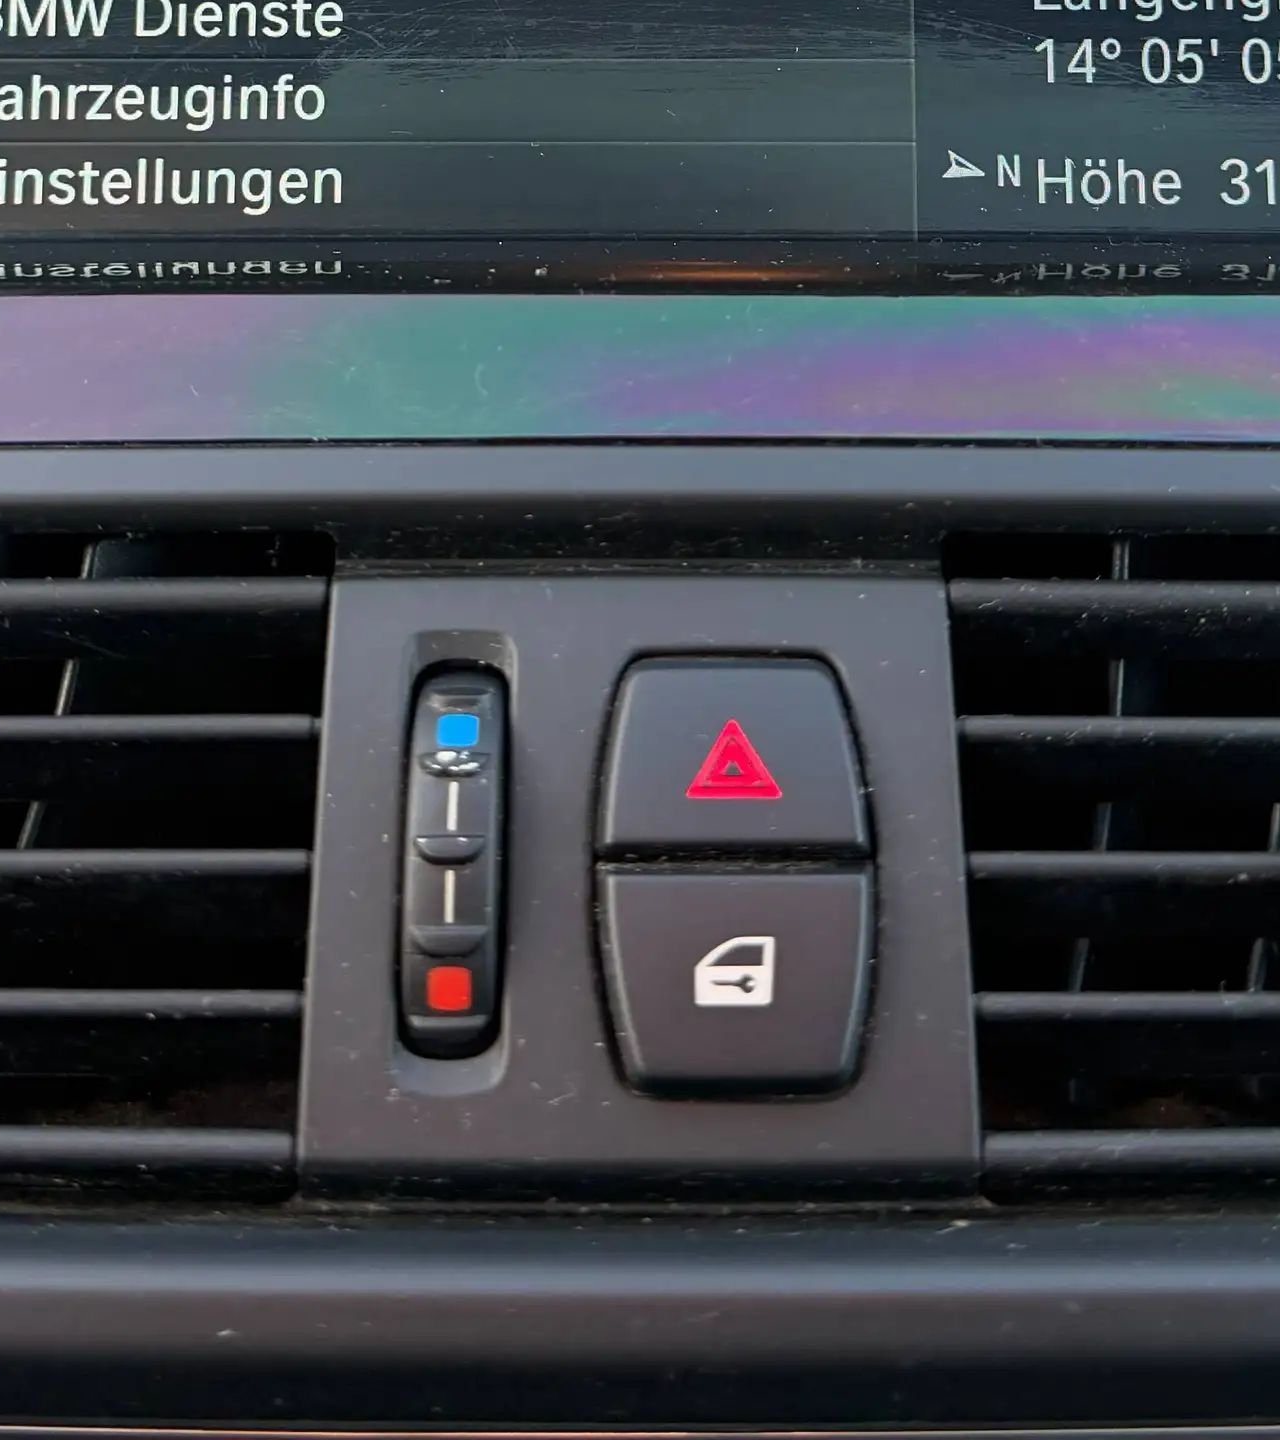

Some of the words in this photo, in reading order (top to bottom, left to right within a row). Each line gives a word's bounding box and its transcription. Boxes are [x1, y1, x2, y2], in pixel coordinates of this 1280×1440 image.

[1034, 38, 1121, 84] 14°
[1141, 37, 1219, 84] 05'
[997, 154, 1021, 187] N
[1037, 156, 1182, 205] Höhe
